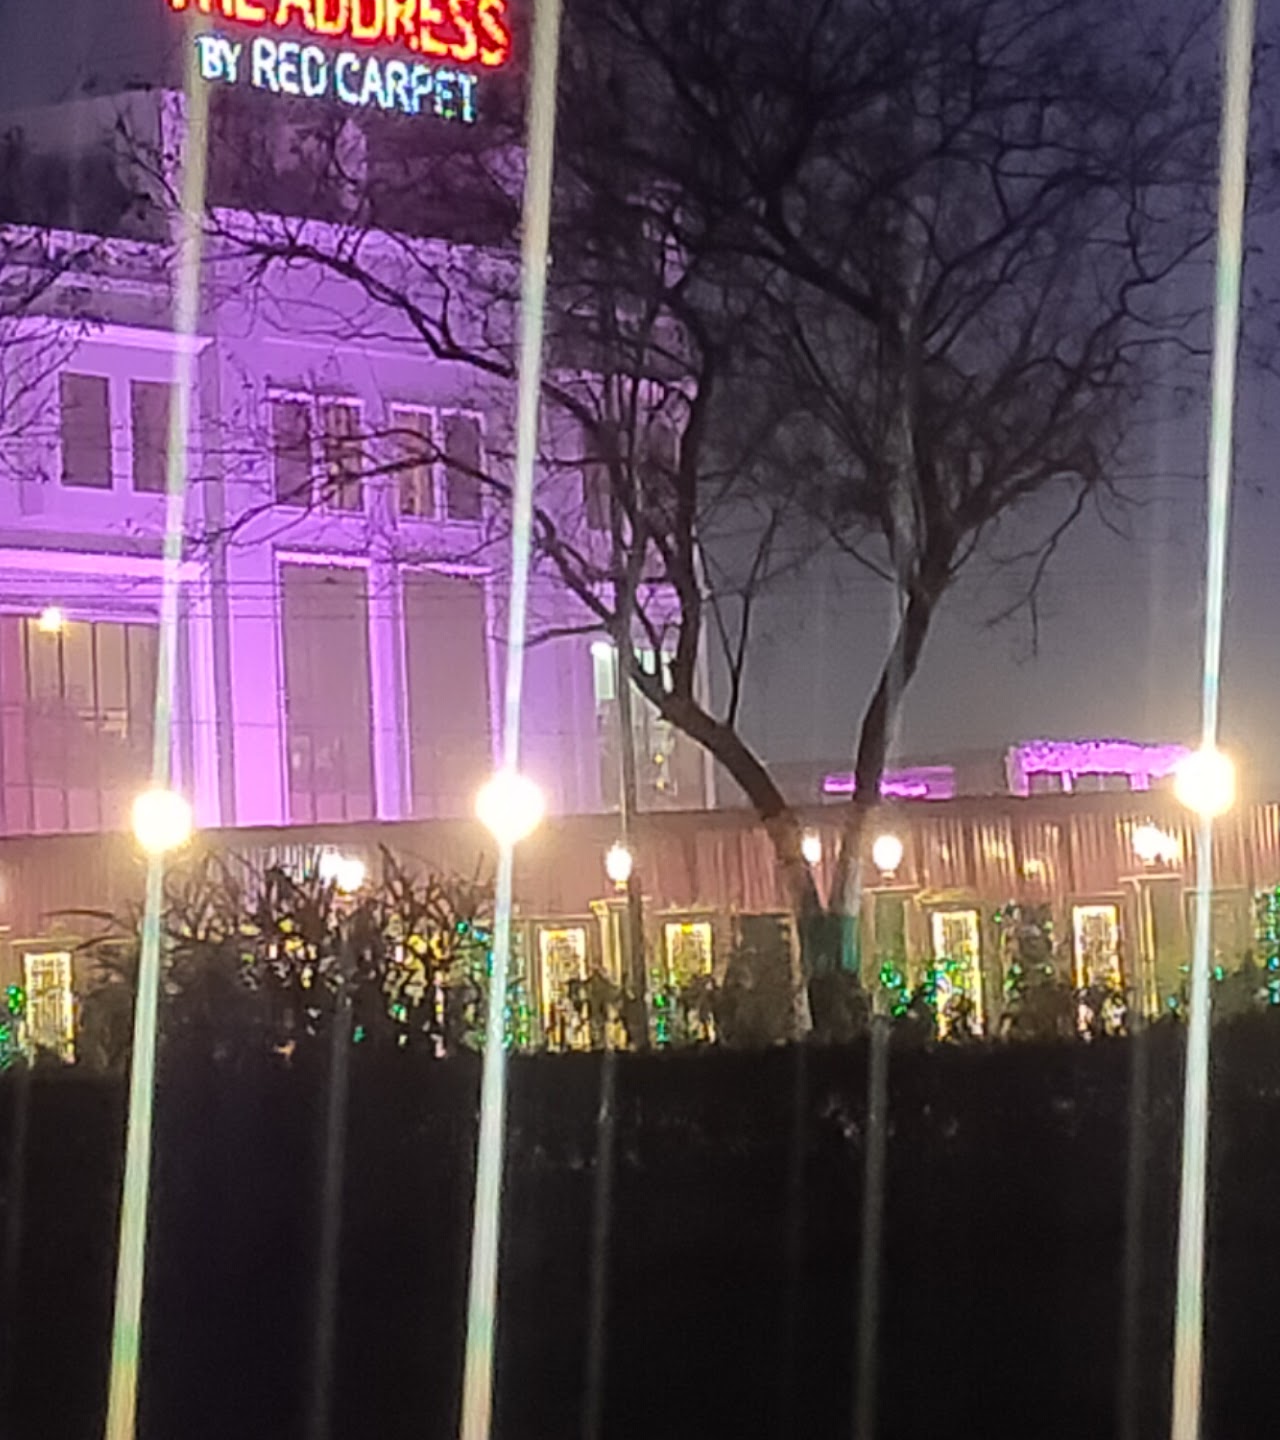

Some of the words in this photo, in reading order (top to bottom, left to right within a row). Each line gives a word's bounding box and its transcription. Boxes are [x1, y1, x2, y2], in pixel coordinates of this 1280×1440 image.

[196, 36, 242, 82] BY
[252, 37, 328, 97] RED
[336, 53, 478, 123] CARPET
